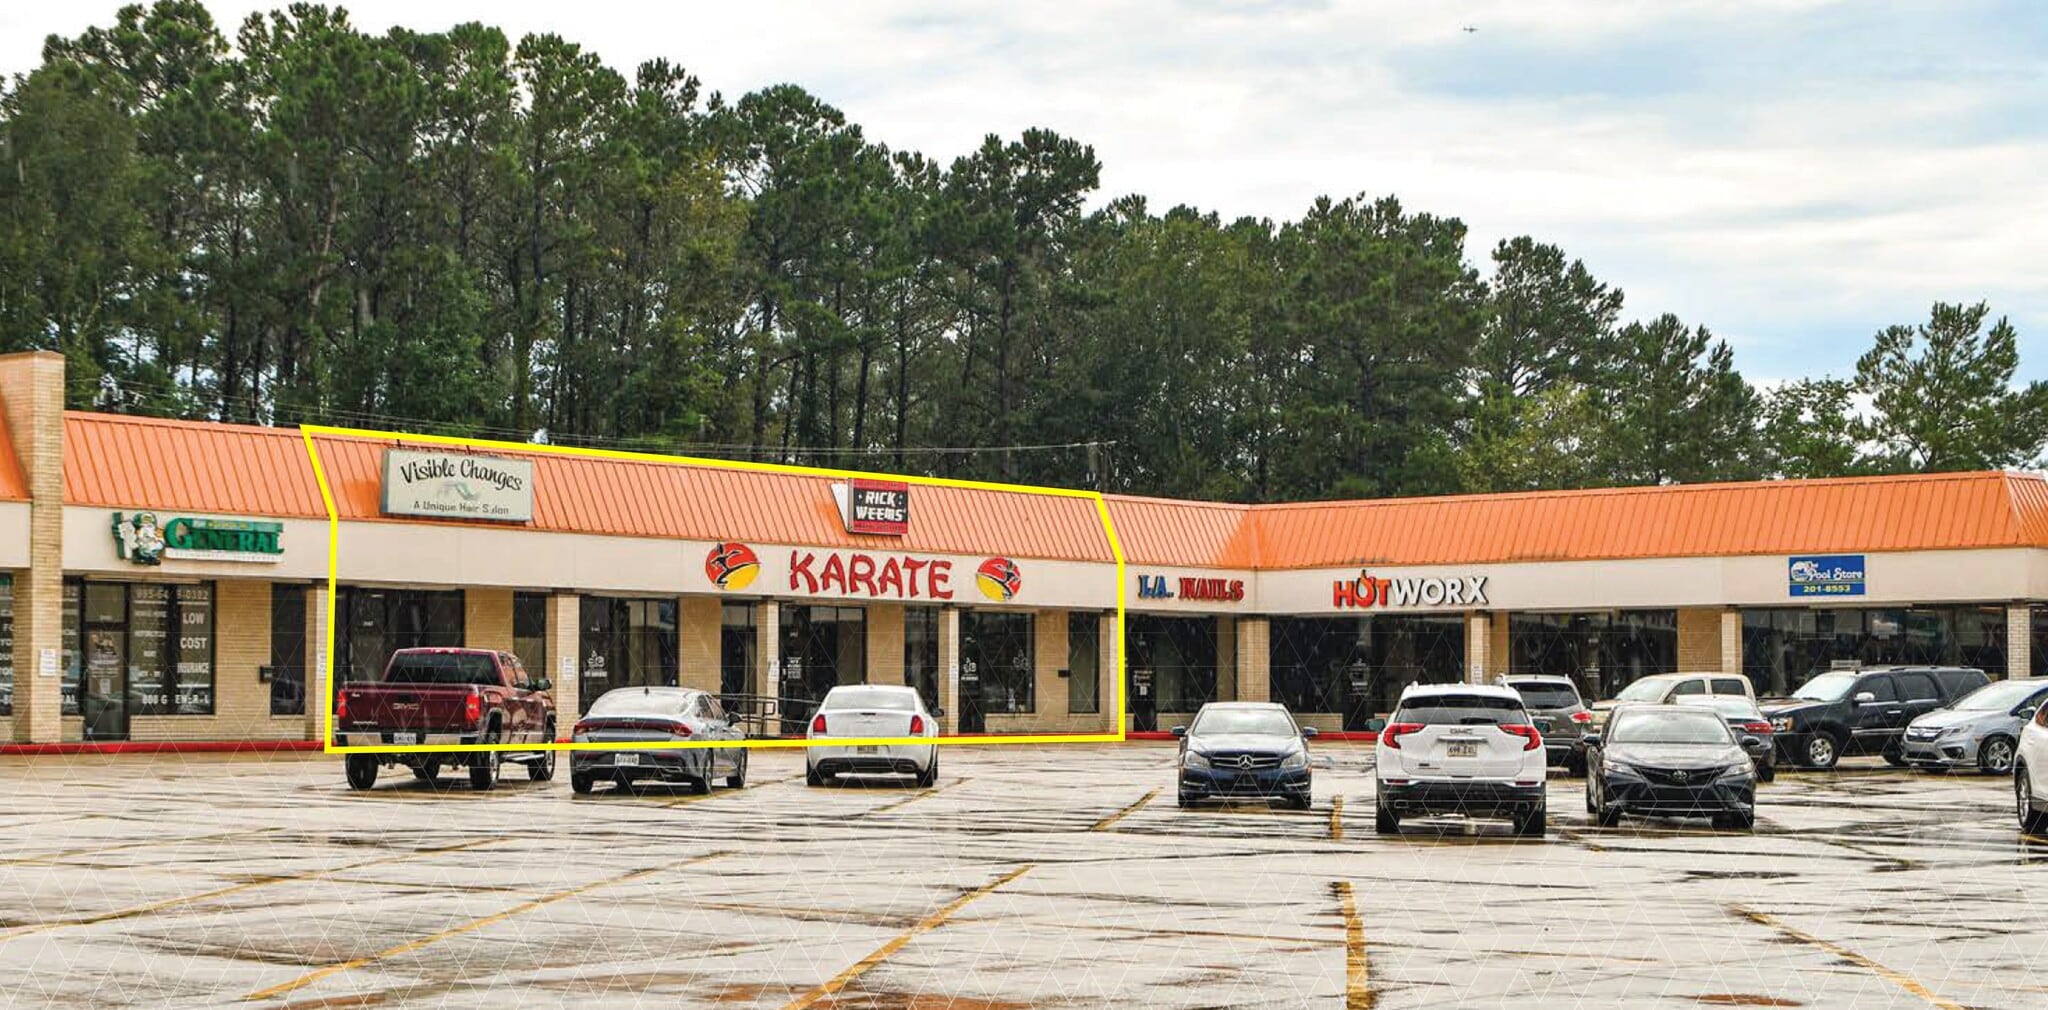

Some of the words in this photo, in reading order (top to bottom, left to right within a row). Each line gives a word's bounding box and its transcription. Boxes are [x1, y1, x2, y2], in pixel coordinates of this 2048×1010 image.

[400, 458, 456, 483] Visible
[460, 460, 522, 490] Changes
[413, 501, 420, 509] A
[423, 501, 456, 513] Unique
[459, 503, 479, 512] Hair
[865, 491, 897, 507] RICK
[164, 518, 284, 553] GENERAL
[790, 550, 953, 598] KARATE
[1806, 567, 1831, 582] Pool
[1833, 567, 1862, 581] Store
[1179, 577, 1244, 600] NAILS
[1333, 569, 1488, 608] HOTWORX
[182, 612, 205, 625] LOW
[180, 637, 207, 649] COST
